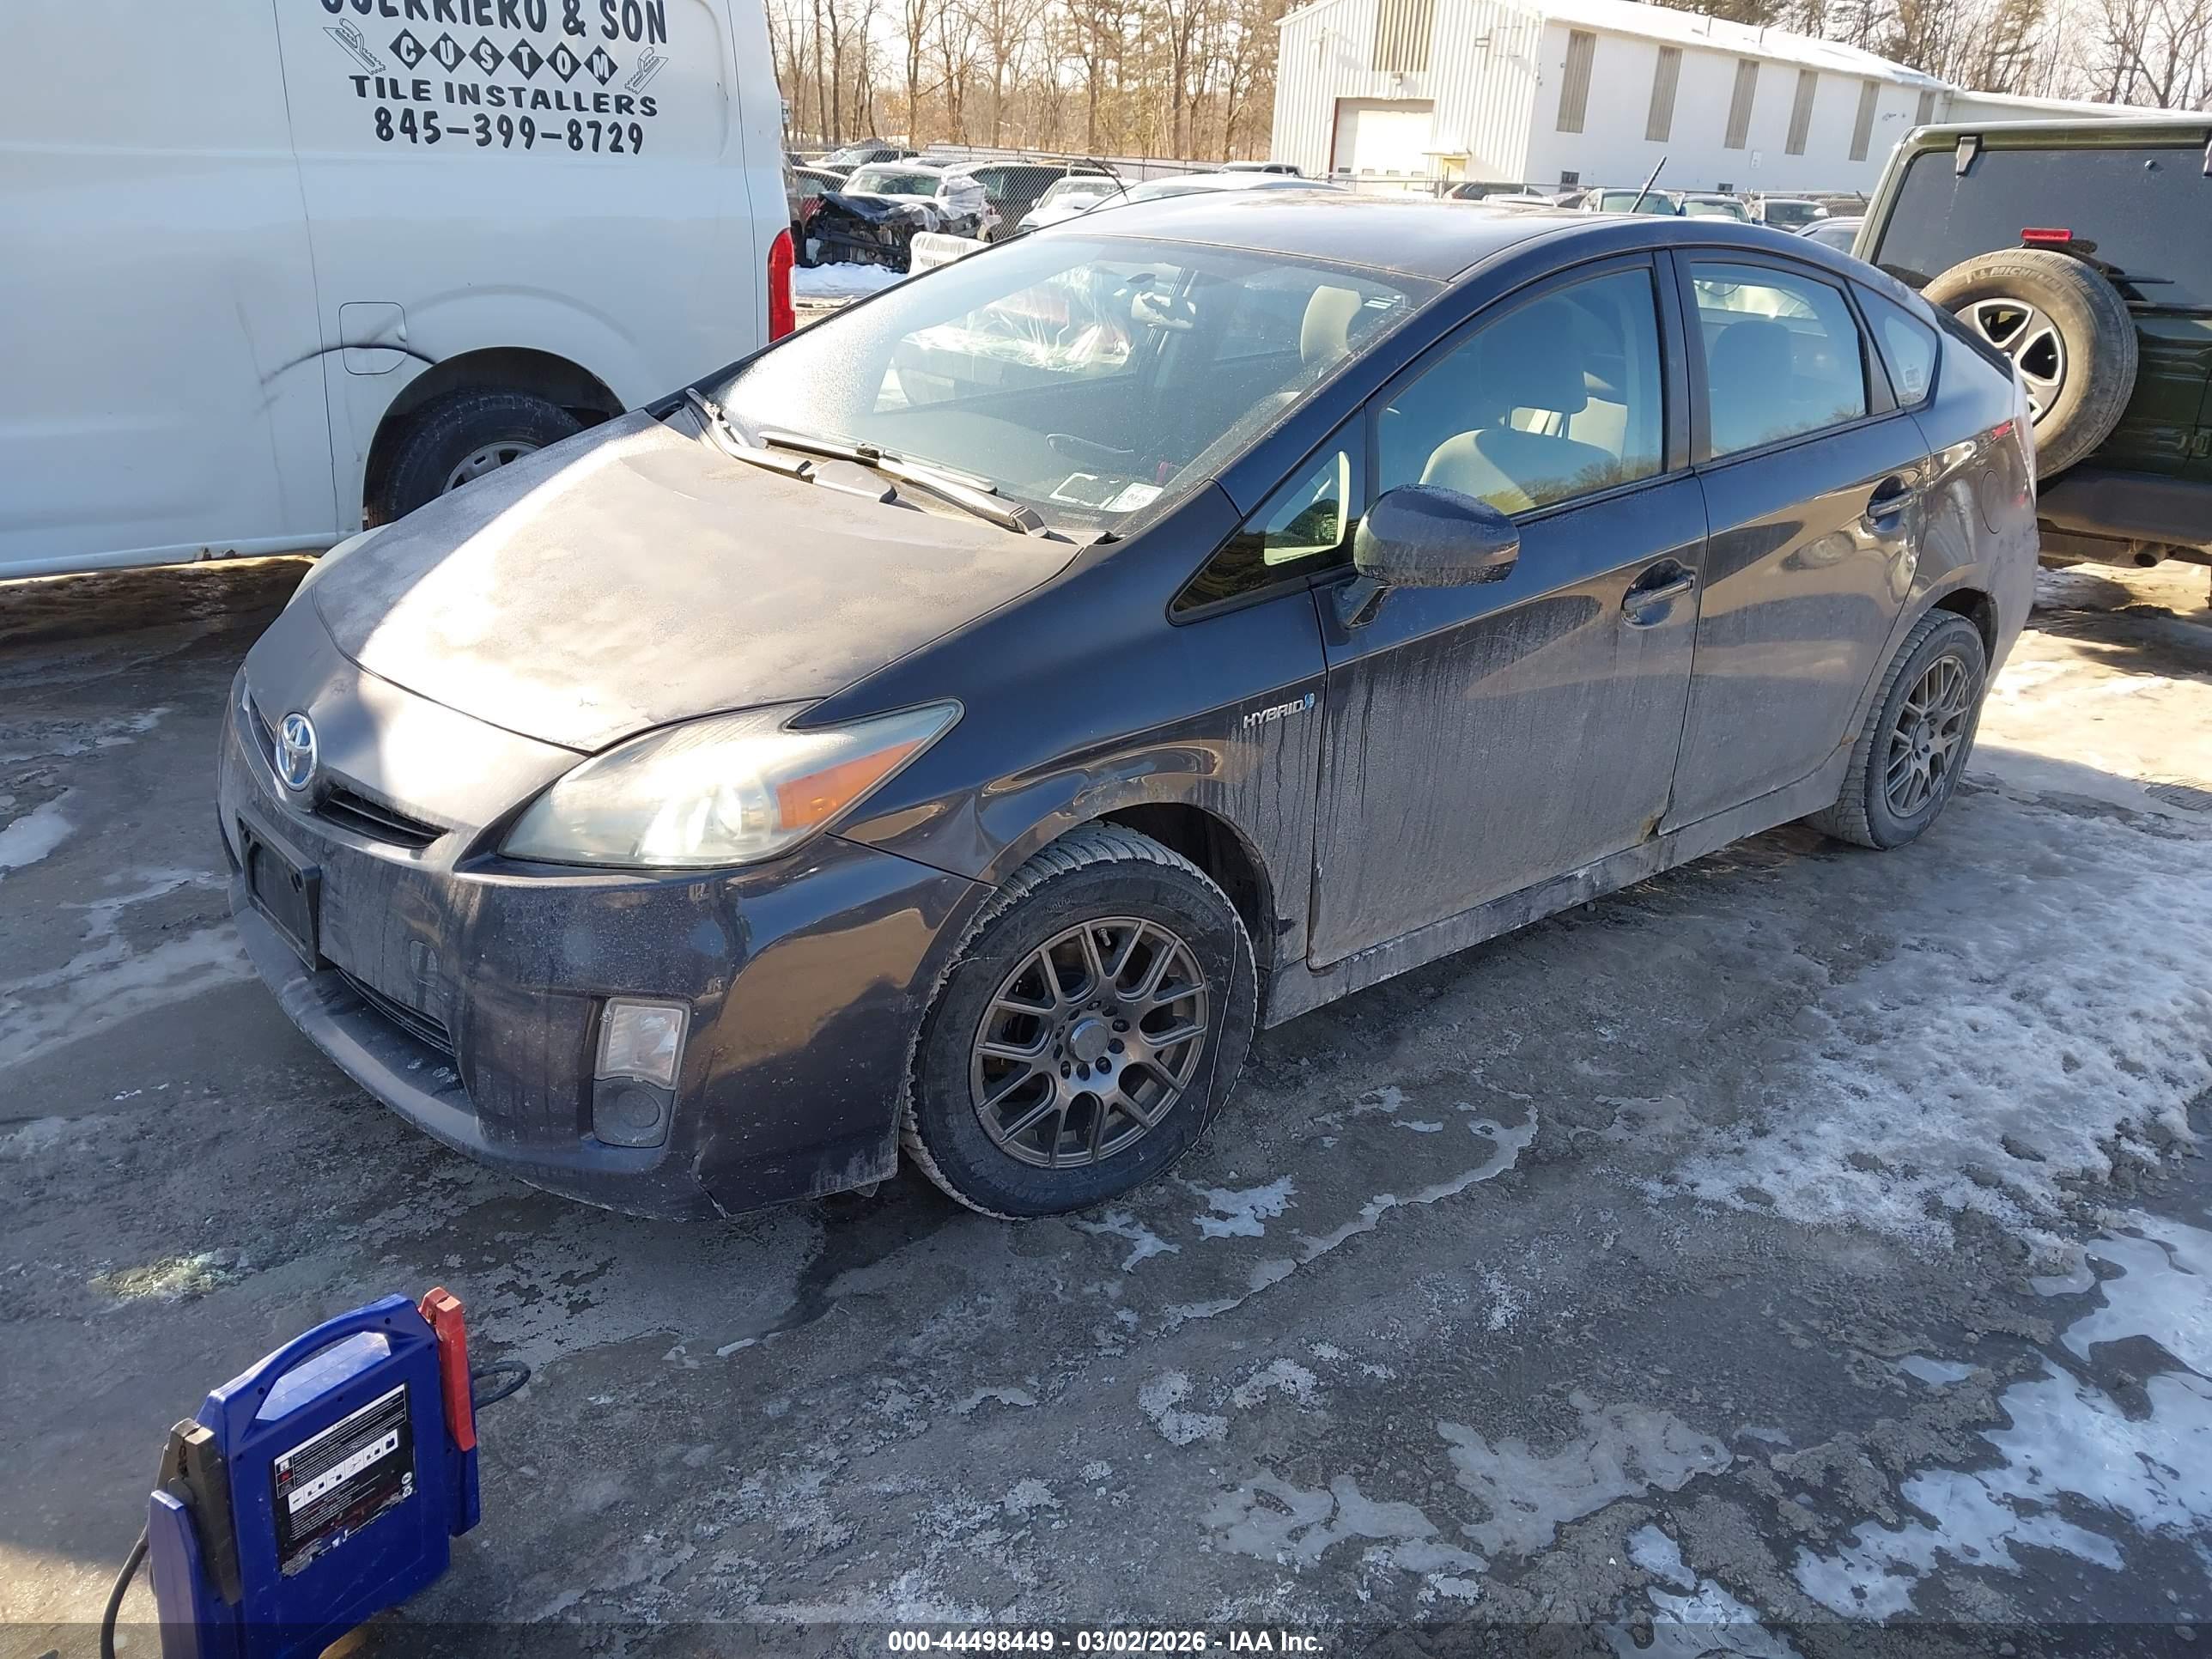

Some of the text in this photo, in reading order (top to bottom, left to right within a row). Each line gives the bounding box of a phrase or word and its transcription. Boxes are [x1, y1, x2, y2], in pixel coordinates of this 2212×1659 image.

[562, 0, 586, 37] &
[600, 0, 666, 44] SON
[400, 36, 609, 79] CUSTOM
[349, 75, 658, 117] TILE INSTALLERS
[374, 106, 643, 155] 845-399-8729
[1243, 699, 1306, 729] HYBRID
